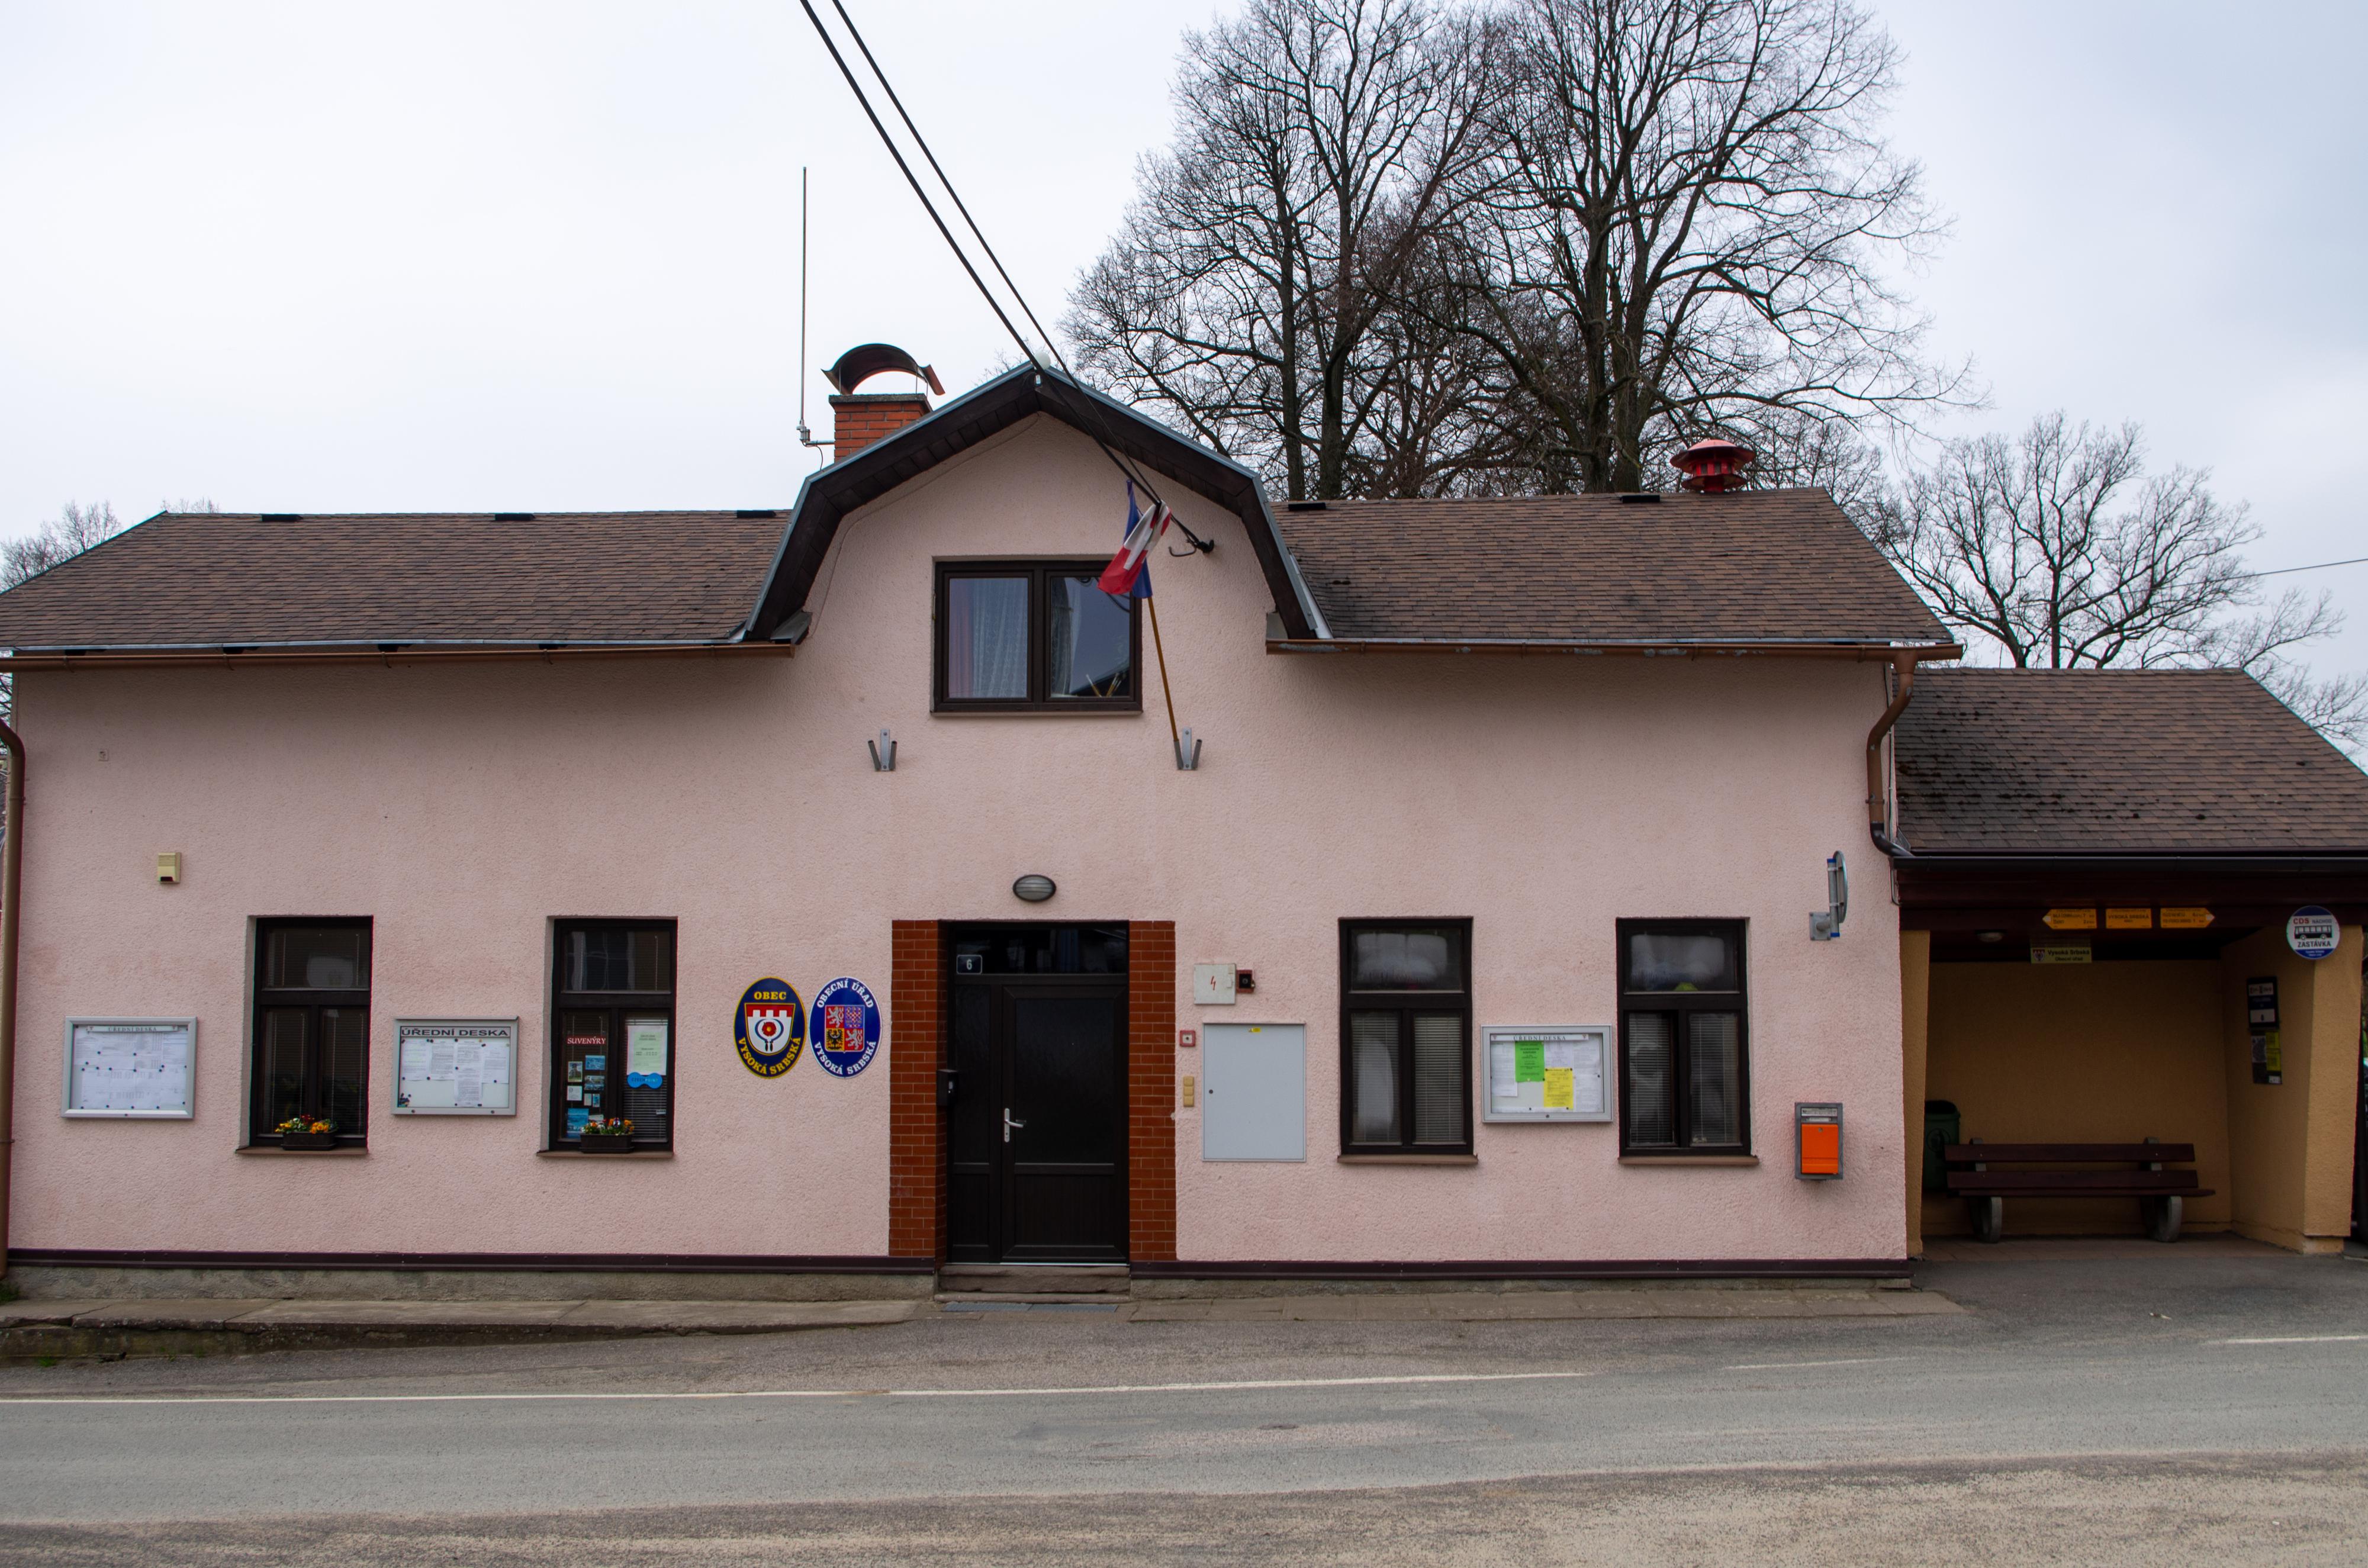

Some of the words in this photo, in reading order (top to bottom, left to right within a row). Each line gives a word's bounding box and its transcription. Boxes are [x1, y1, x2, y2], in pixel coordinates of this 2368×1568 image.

[966, 958, 973, 971] 6
[754, 991, 787, 1000] OBEC
[817, 978, 848, 1009] OBECNÍ
[851, 982, 874, 1009] ÚŘAD
[567, 1036, 606, 1044] SUVENÝRY
[738, 1037, 767, 1075] VYSOKÁ
[770, 1037, 801, 1075] SRBSKÁ
[815, 1041, 843, 1075] VYSOKÁ
[847, 1041, 877, 1075] SRBSKÁ
